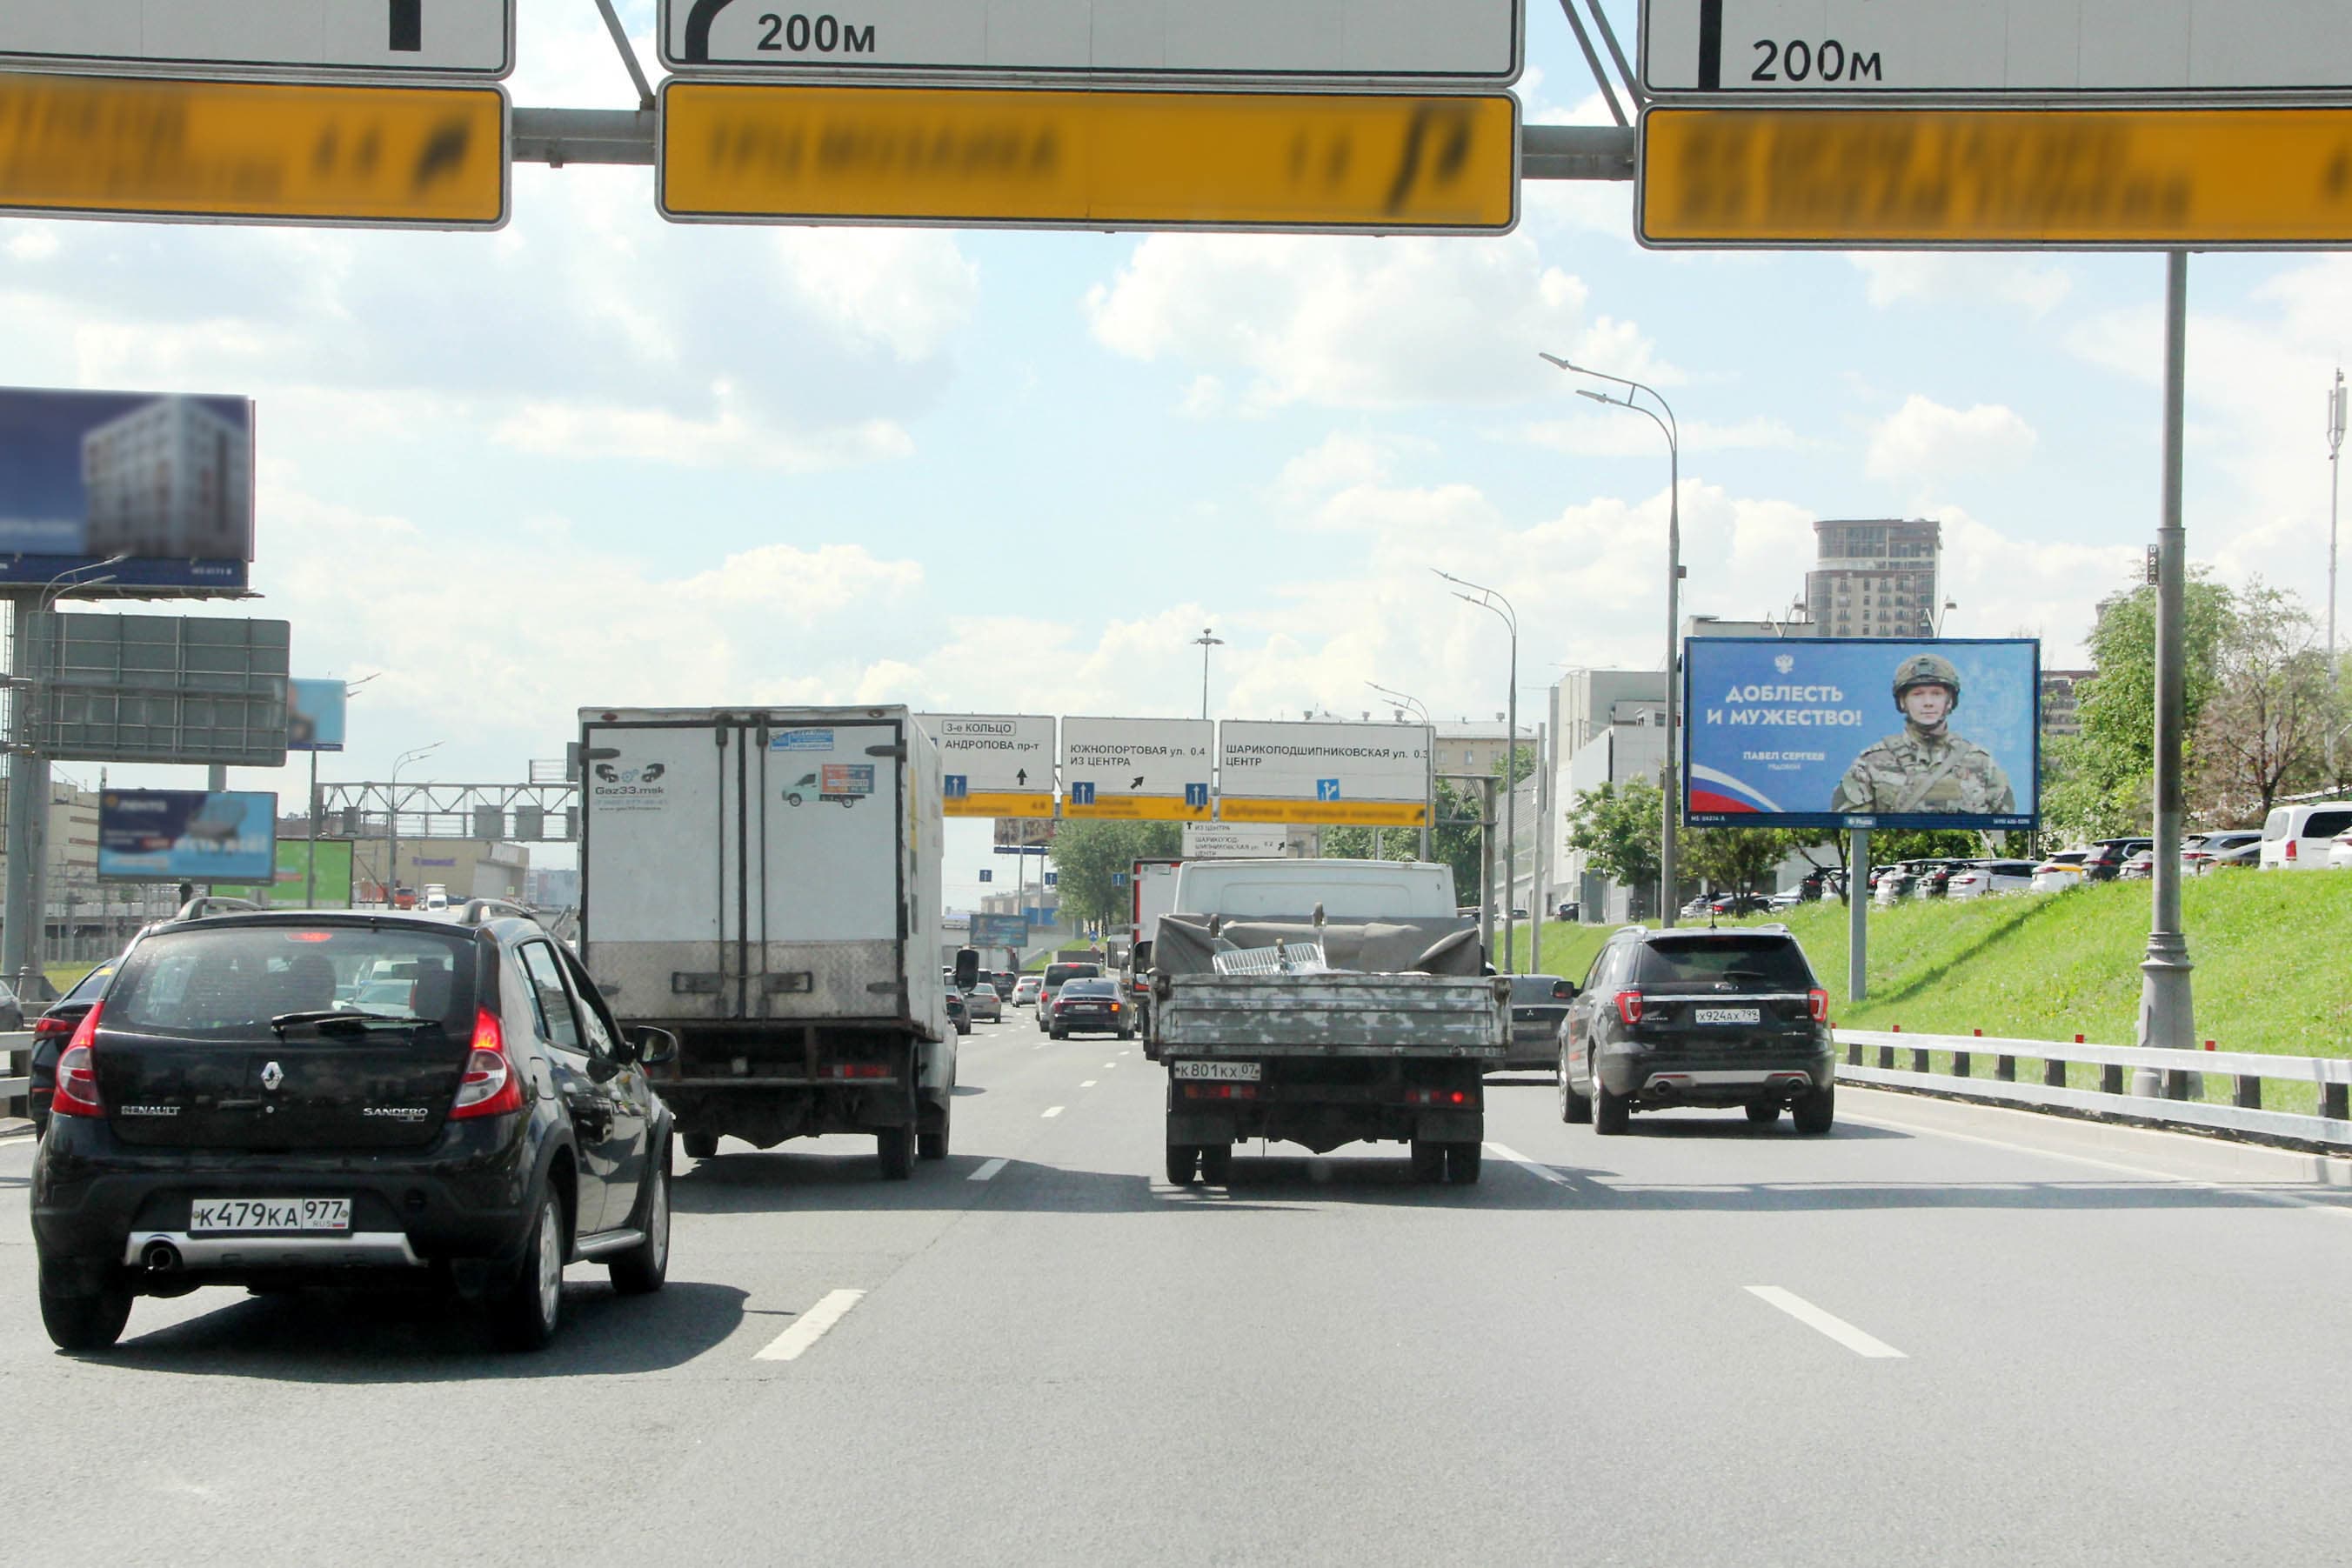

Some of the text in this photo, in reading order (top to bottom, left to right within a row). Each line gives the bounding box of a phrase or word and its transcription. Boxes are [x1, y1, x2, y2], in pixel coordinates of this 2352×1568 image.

[1725, 685, 1844, 704] ДОБЛЕСТЬ
[1706, 710, 1862, 726] И МУЖЕСТВО!
[966, 724, 1012, 734] КОЛЬЦО
[945, 739, 1040, 752] АНДРОПОВА пр-т
[1070, 744, 1206, 757] ЮЖНОПОРТОВАЯ ул. 0.4
[1226, 744, 1390, 757] ШАРИКОПОДШИПНИКОВСКАЯ
[1392, 750, 1408, 760] ул.
[1742, 751, 1779, 760] ПАВЕЛ
[1070, 757, 1131, 767] ИЗ ЦЕНТРА
[1226, 757, 1262, 767] ЦЕНТР
[121, 1105, 181, 1116] RENAULT
[363, 1107, 429, 1117] SANDERO
[199, 1200, 344, 1227] К479КА 977
